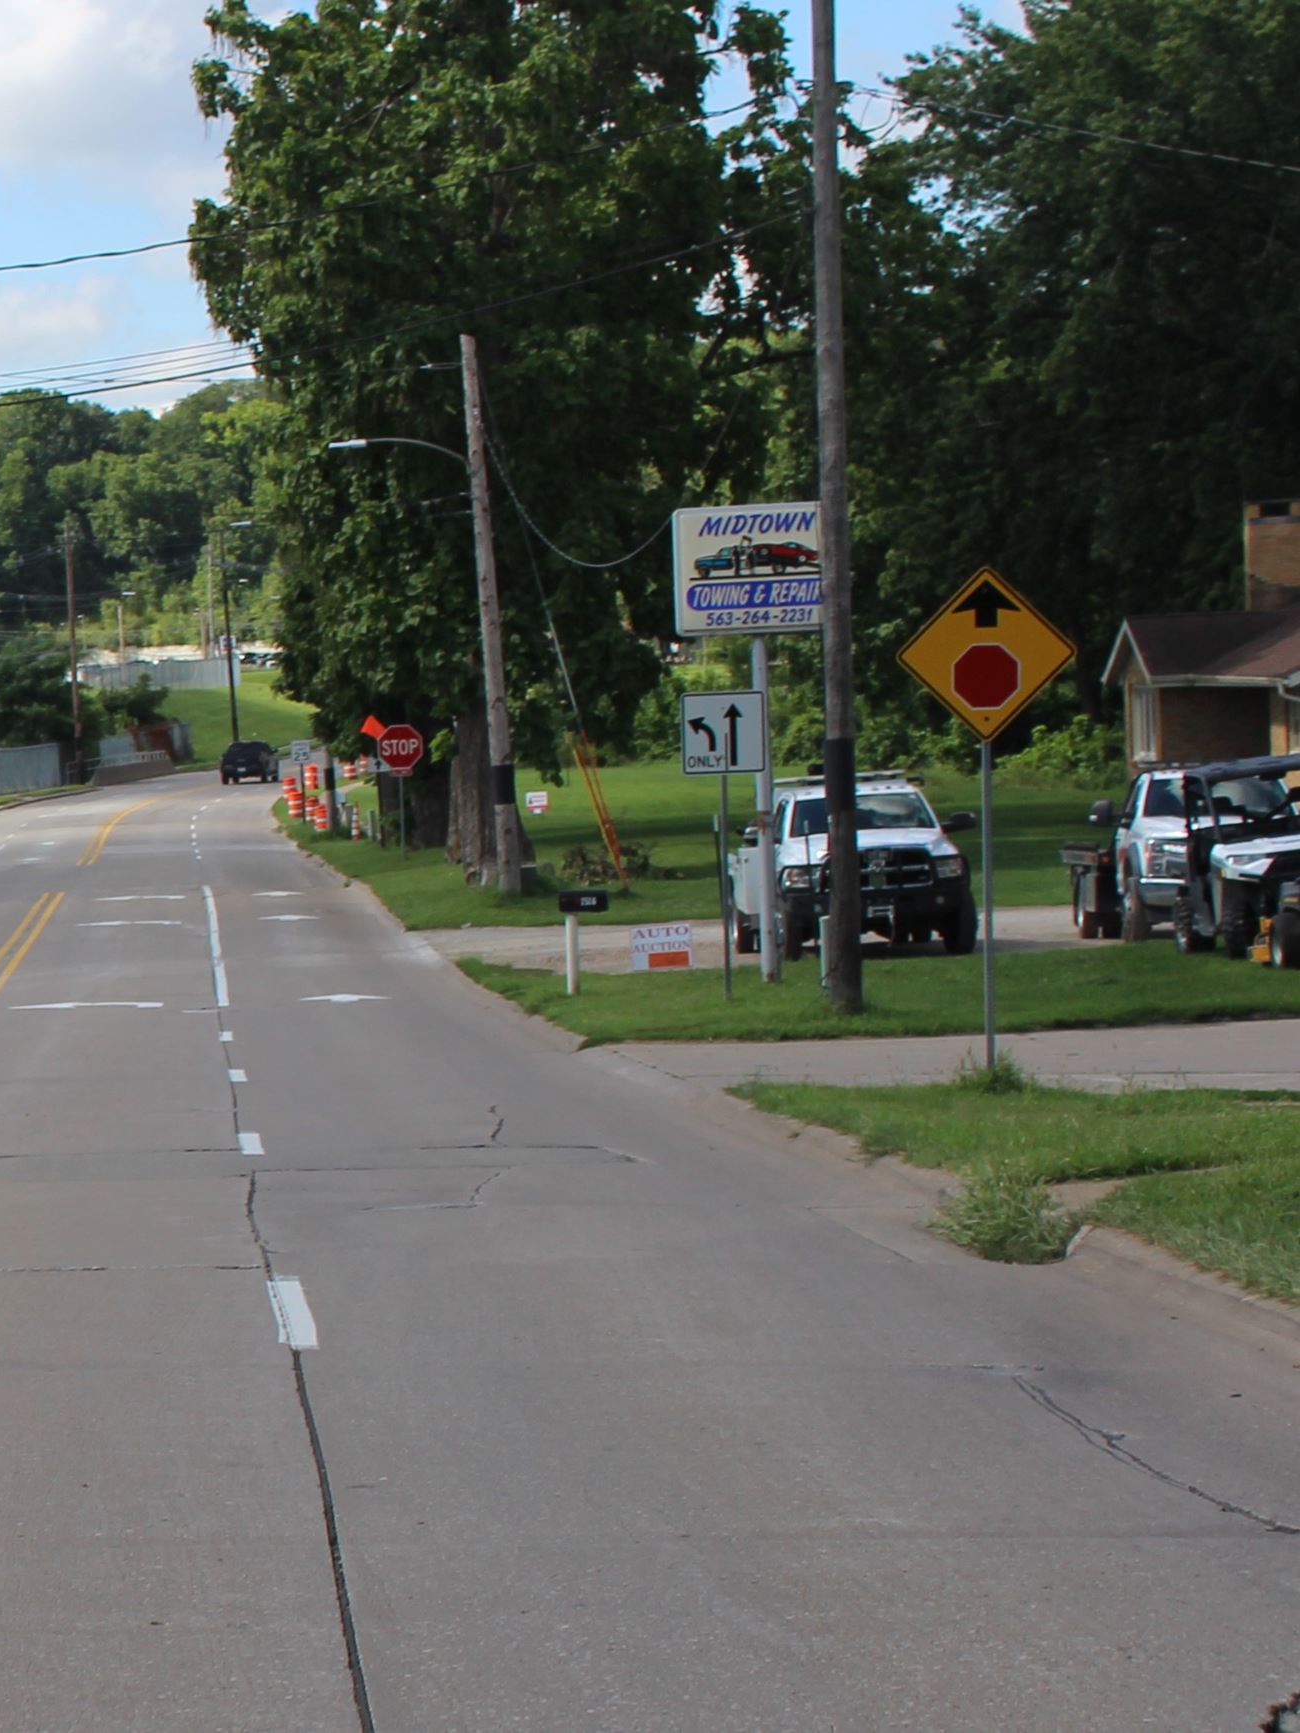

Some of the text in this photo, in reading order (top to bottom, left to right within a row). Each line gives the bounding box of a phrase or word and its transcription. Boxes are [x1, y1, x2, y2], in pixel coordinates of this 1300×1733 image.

[698, 511, 817, 537] MIDTOWN
[692, 584, 751, 608] TOWING
[754, 585, 767, 604] &
[705, 608, 813, 627] 563-264-2231
[381, 738, 420, 756] STOP
[293, 751, 310, 762] 25
[687, 754, 723, 768] ONLY
[632, 925, 689, 939] AUTO
[631, 940, 692, 954] AUCTION
